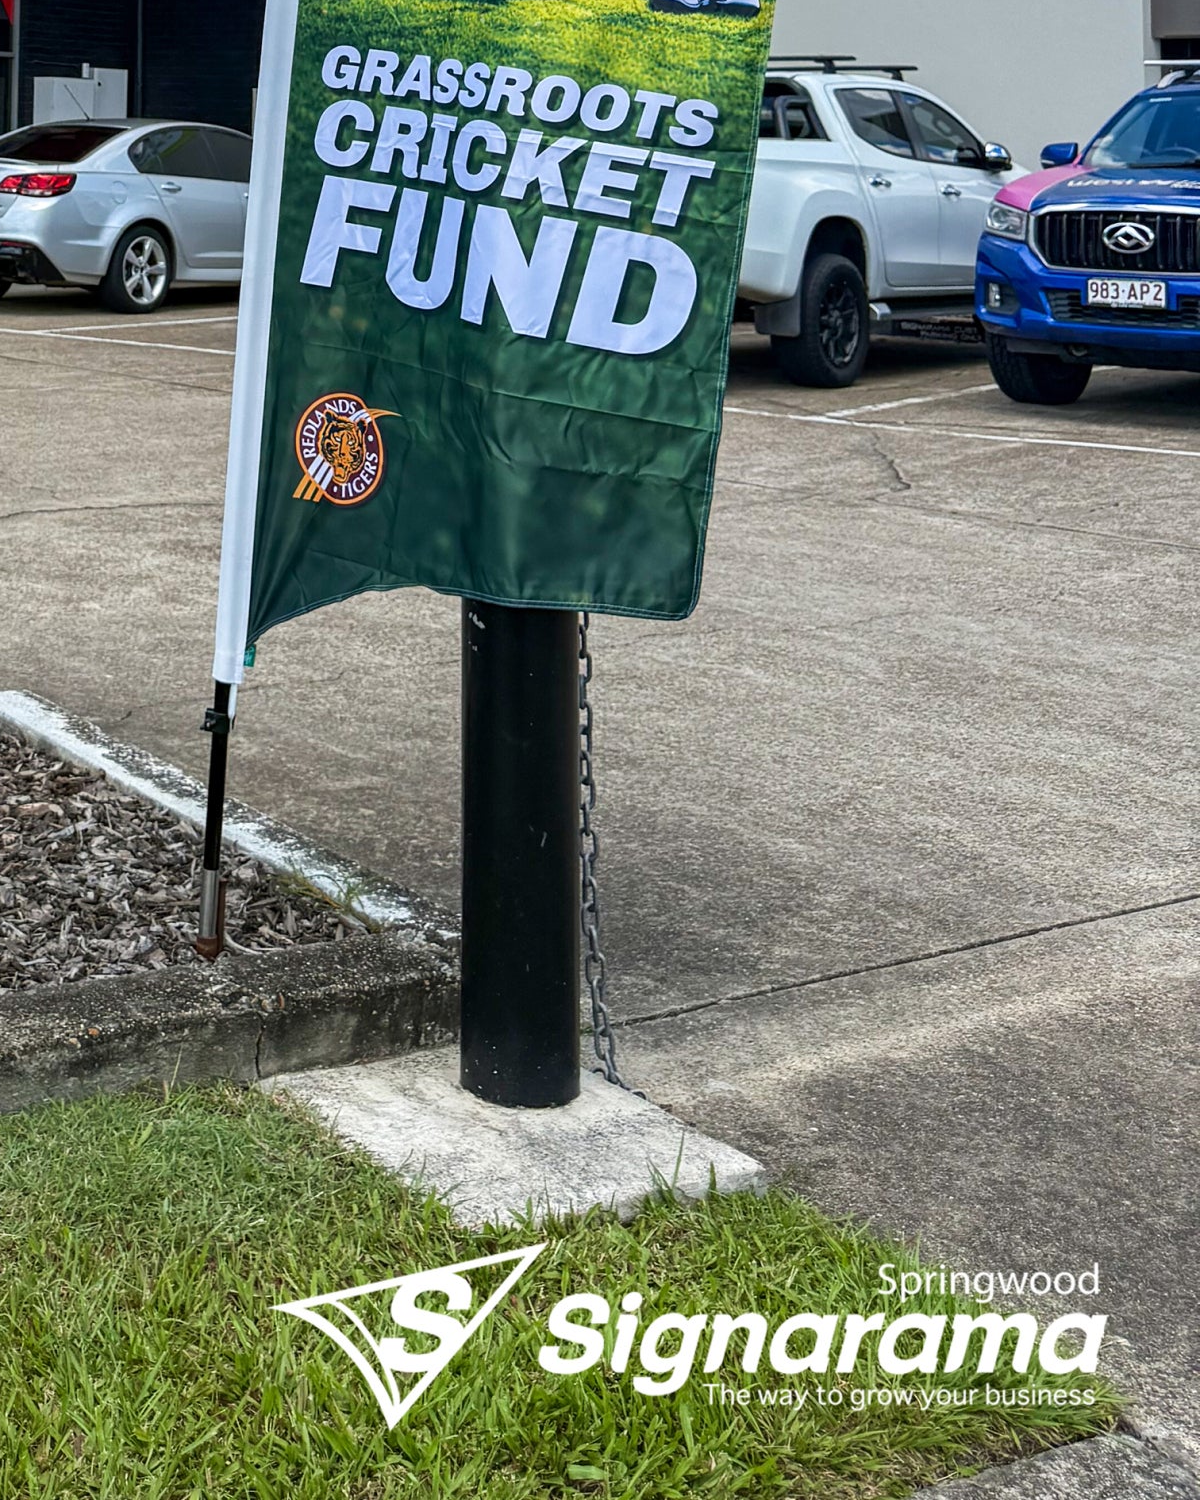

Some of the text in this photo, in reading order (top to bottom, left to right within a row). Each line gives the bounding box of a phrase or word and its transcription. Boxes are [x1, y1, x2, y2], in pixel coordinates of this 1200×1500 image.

[321, 45, 719, 147] GRASSROOTS
[314, 99, 716, 227] CRICKET
[300, 174, 698, 355] FUND
[301, 399, 357, 459] REDLANDS
[341, 451, 379, 498] TIGERS
